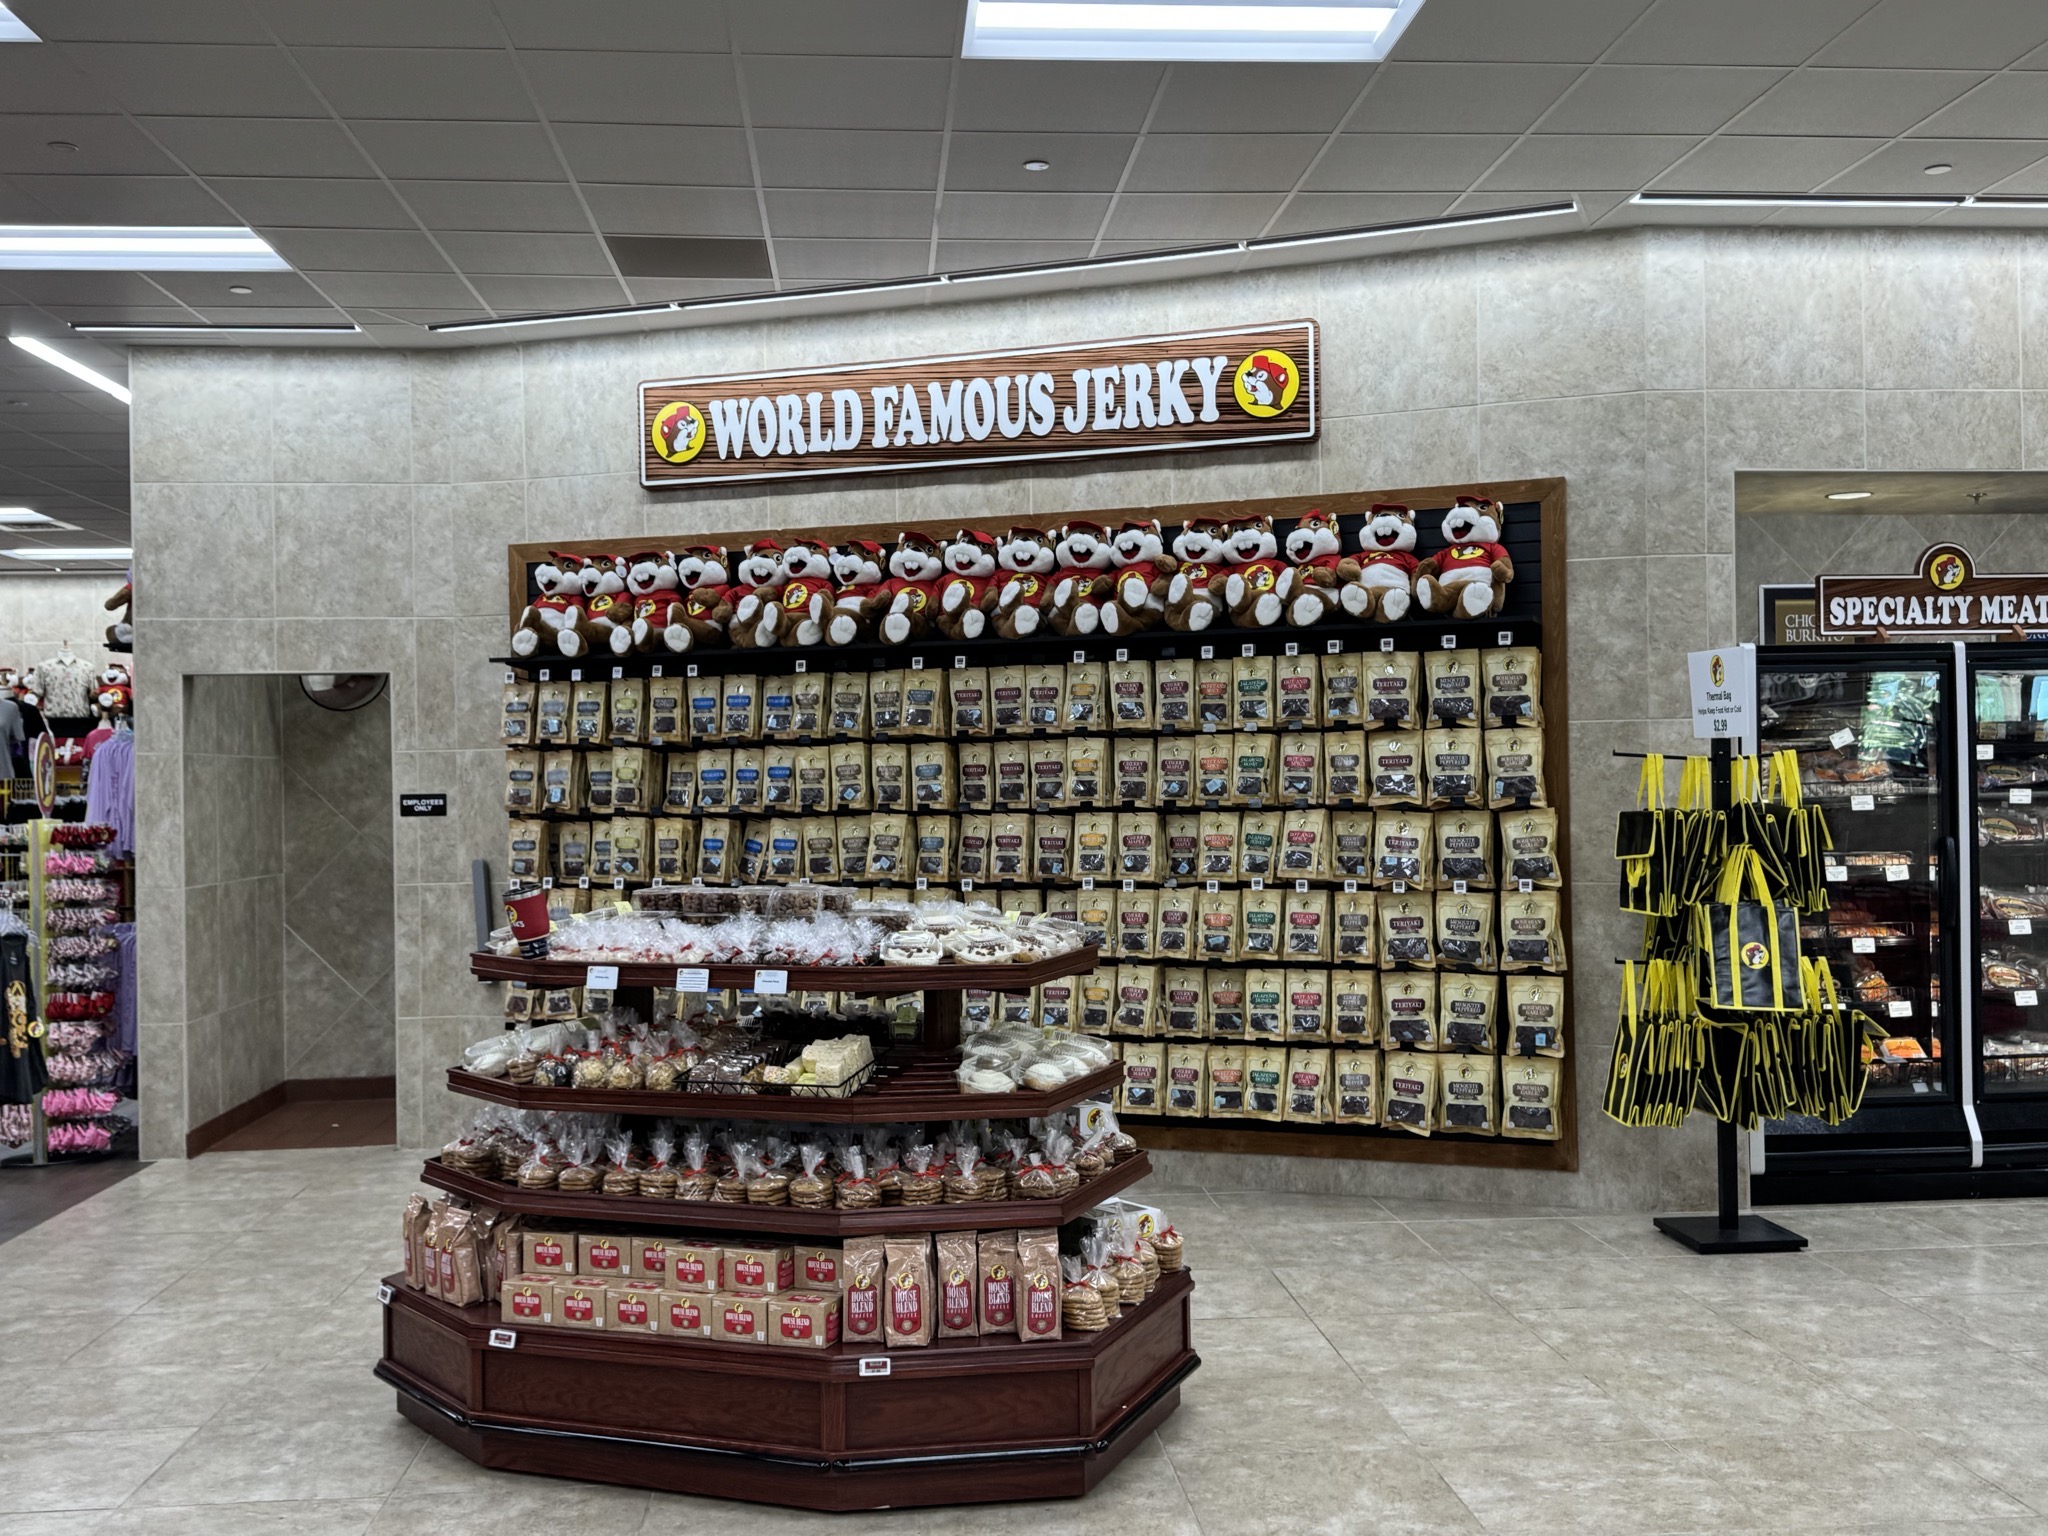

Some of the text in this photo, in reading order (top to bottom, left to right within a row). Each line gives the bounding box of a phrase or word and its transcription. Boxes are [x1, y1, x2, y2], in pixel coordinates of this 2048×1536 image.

[708, 355, 1229, 461] WORLD FAMOUS JERKY
[1830, 594, 2048, 626] SPECIALTY MEAT
[1706, 691, 1732, 702] Thermal Bag
[1714, 719, 1727, 731] $2.99
[1395, 1082, 1421, 1091] TERIYAKI
[678, 1261, 702, 1270] HOUSE BLEND
[947, 1286, 967, 1297] HOUSE
[988, 1282, 1009, 1293] HOUSE
[852, 1291, 873, 1302] HOUSE
[896, 1290, 917, 1302] HOUSE
[988, 1293, 1010, 1304] BLEND
[1032, 1291, 1052, 1302] HOUSE
[579, 1300, 591, 1308] BLEND
[852, 1302, 874, 1313] BLEND
[896, 1302, 917, 1313] BLEND
[947, 1297, 968, 1308] BLEND
[1032, 1302, 1053, 1313] BLEND
[726, 1312, 752, 1322] HOUSE BLEND
[783, 1316, 810, 1326] HOUSE BLEND
